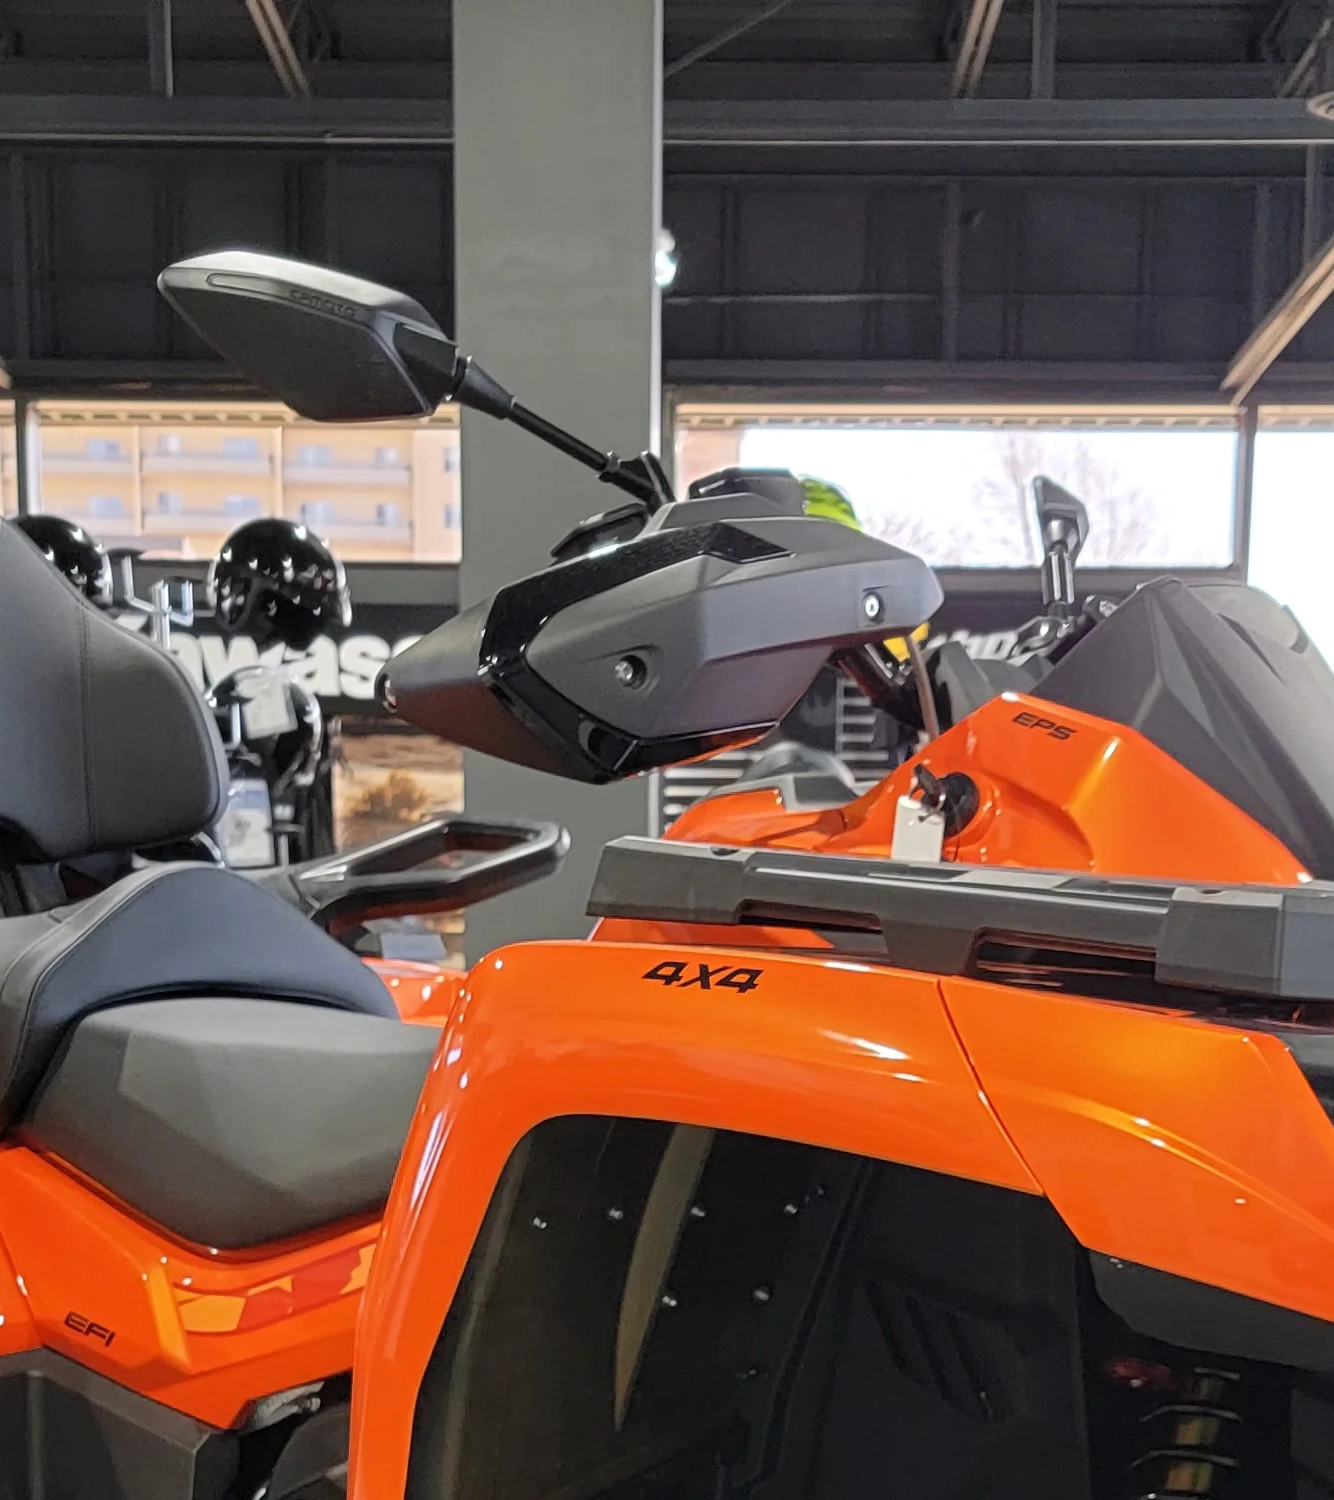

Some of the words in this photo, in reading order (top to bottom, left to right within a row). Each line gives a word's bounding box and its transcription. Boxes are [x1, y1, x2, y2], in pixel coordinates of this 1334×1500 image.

[1012, 711, 1077, 740] EPS
[641, 961, 764, 994] 4X4
[64, 1310, 116, 1348] EFI
